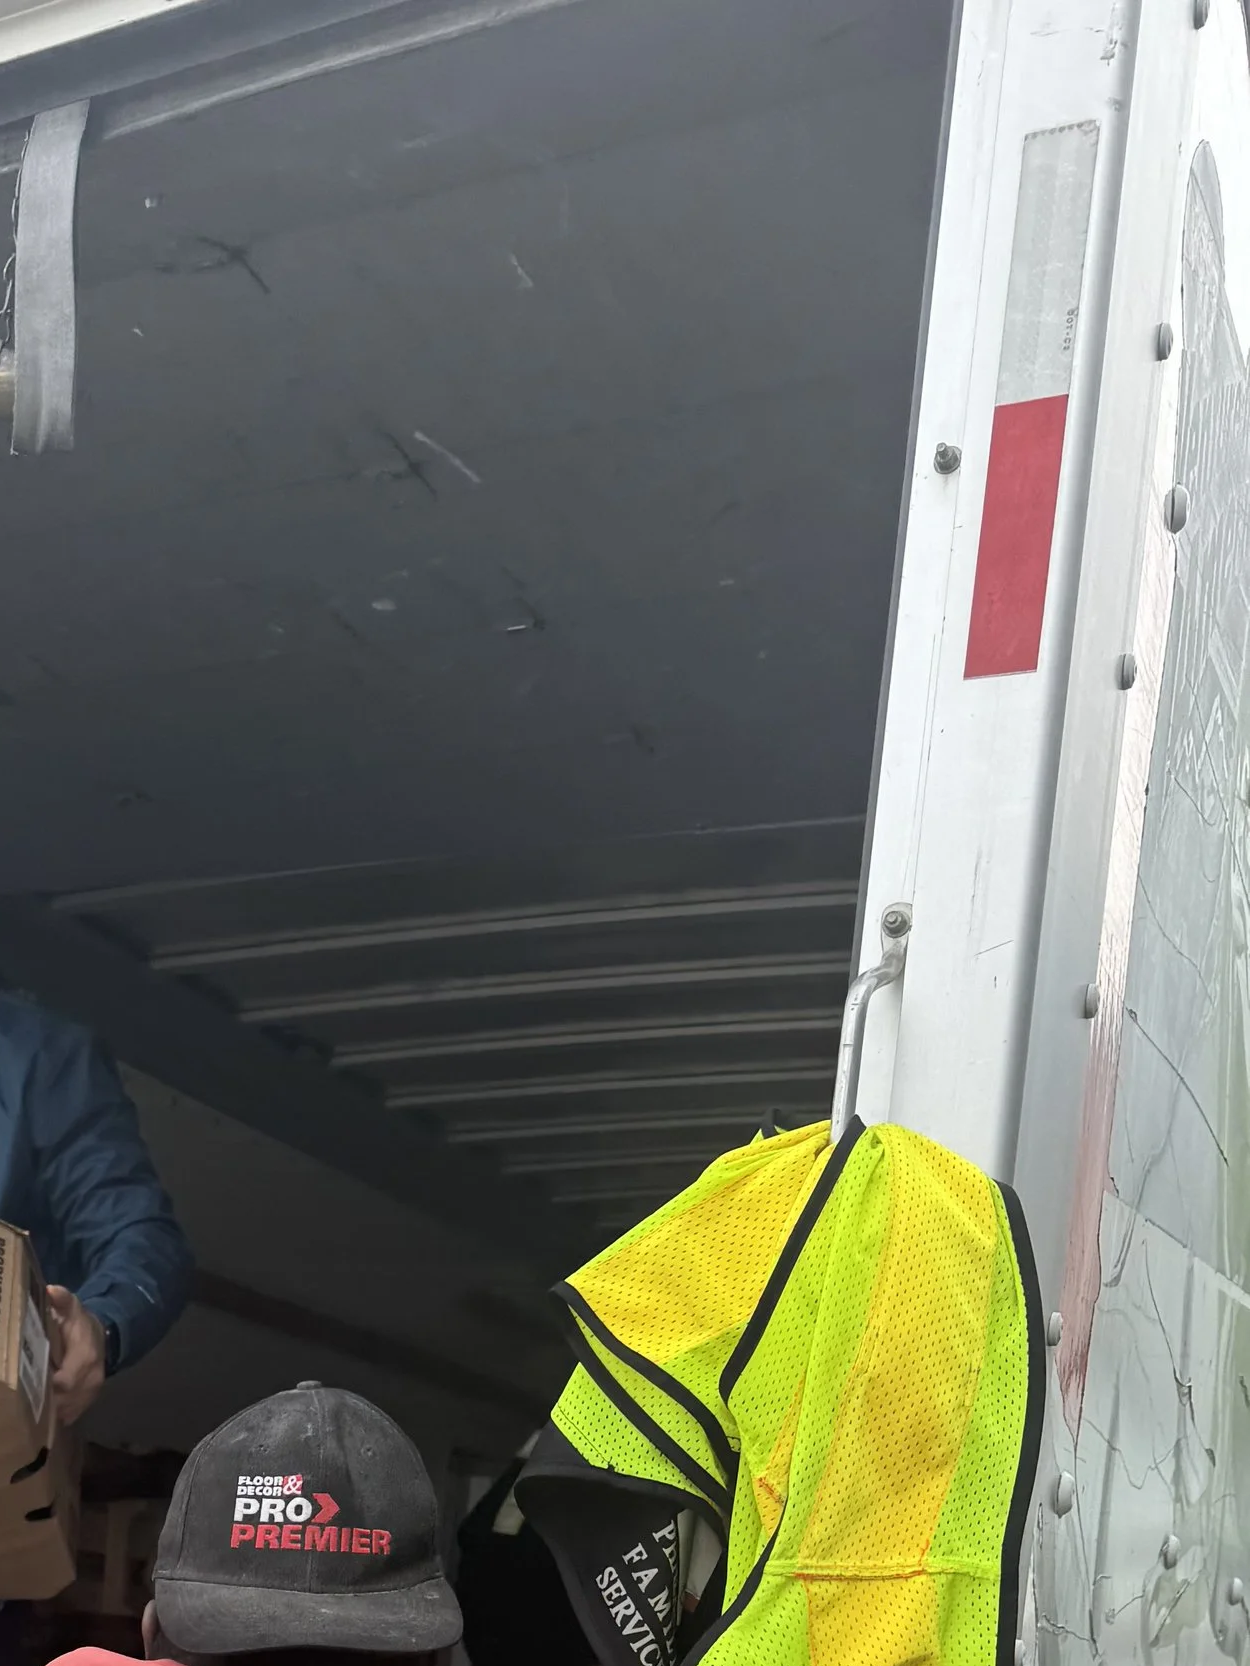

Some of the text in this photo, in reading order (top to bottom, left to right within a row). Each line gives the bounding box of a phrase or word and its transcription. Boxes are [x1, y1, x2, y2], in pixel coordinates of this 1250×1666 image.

[237, 1474, 303, 1495] FLOOR &
[237, 1486, 283, 1496] DECOR
[233, 1497, 312, 1522] PRO
[231, 1524, 391, 1555] PREMIER
